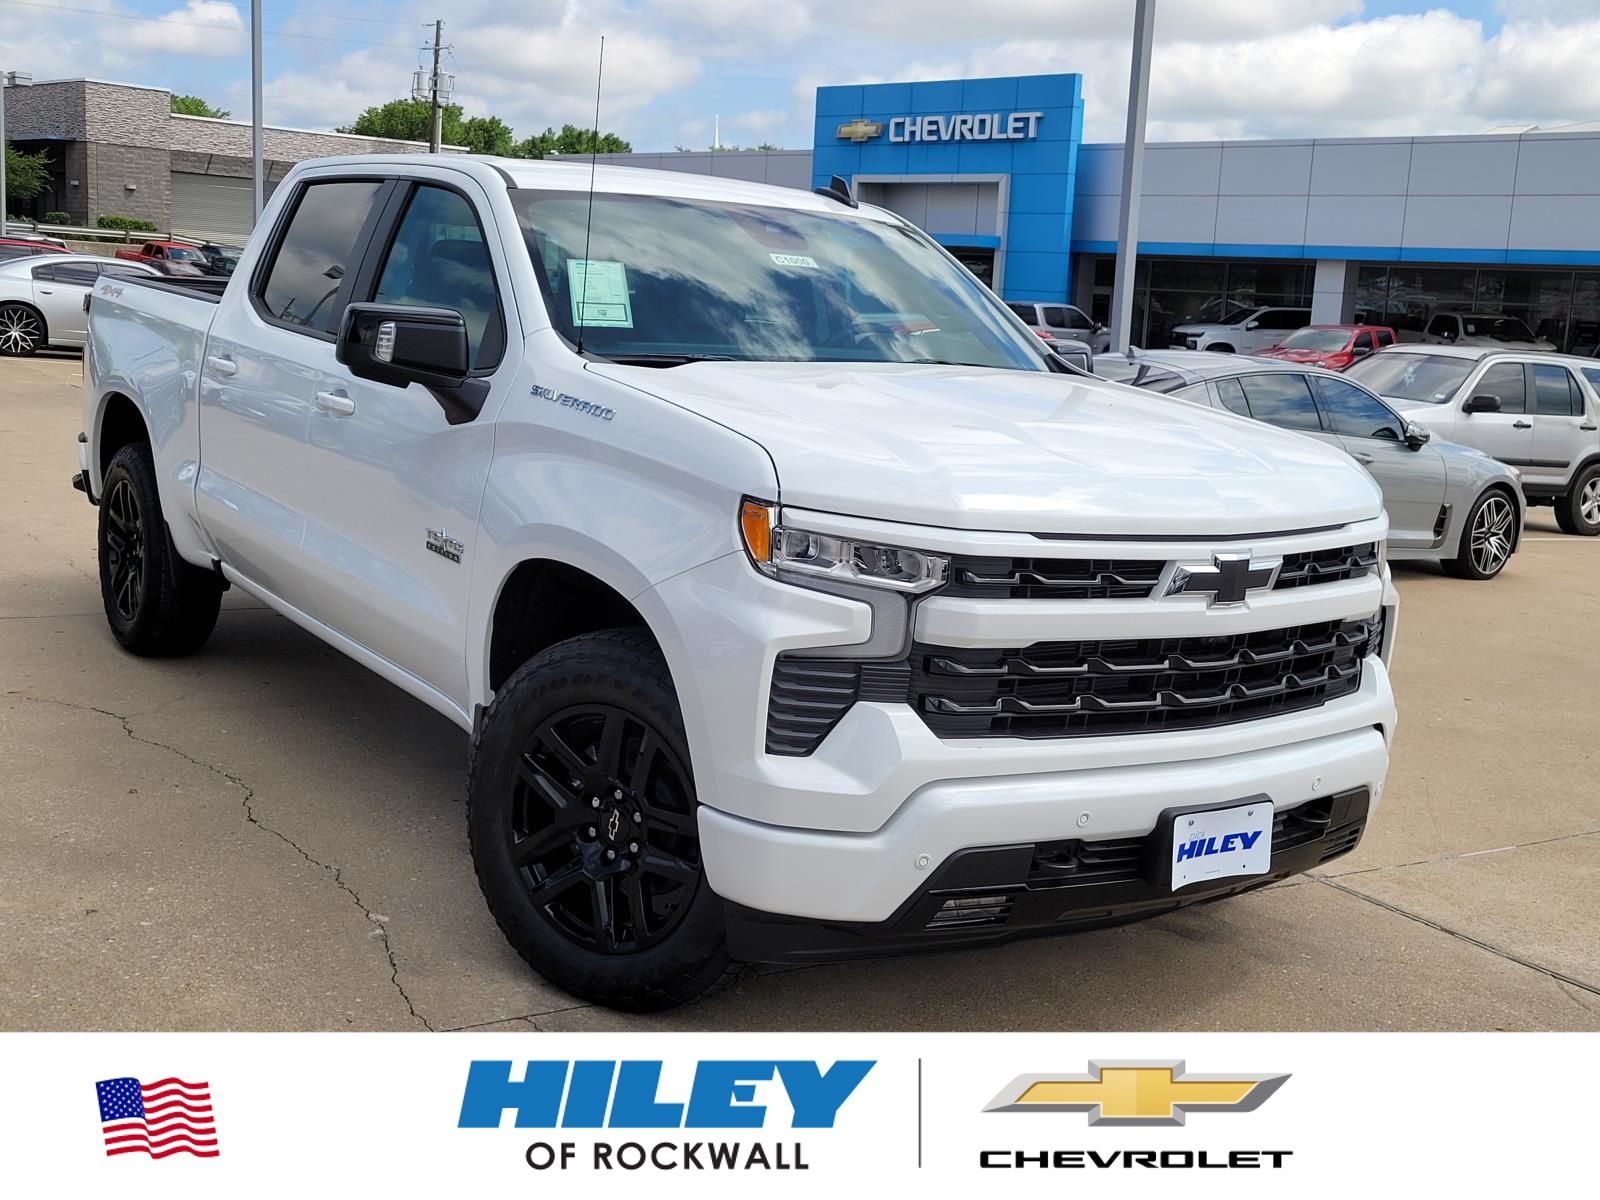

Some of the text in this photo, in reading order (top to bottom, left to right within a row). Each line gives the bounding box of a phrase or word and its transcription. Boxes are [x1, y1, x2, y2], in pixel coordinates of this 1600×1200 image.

[889, 111, 1044, 143] CHEVROLET
[530, 384, 617, 421] SILVERADO
[1176, 830, 1264, 864] HILEY
